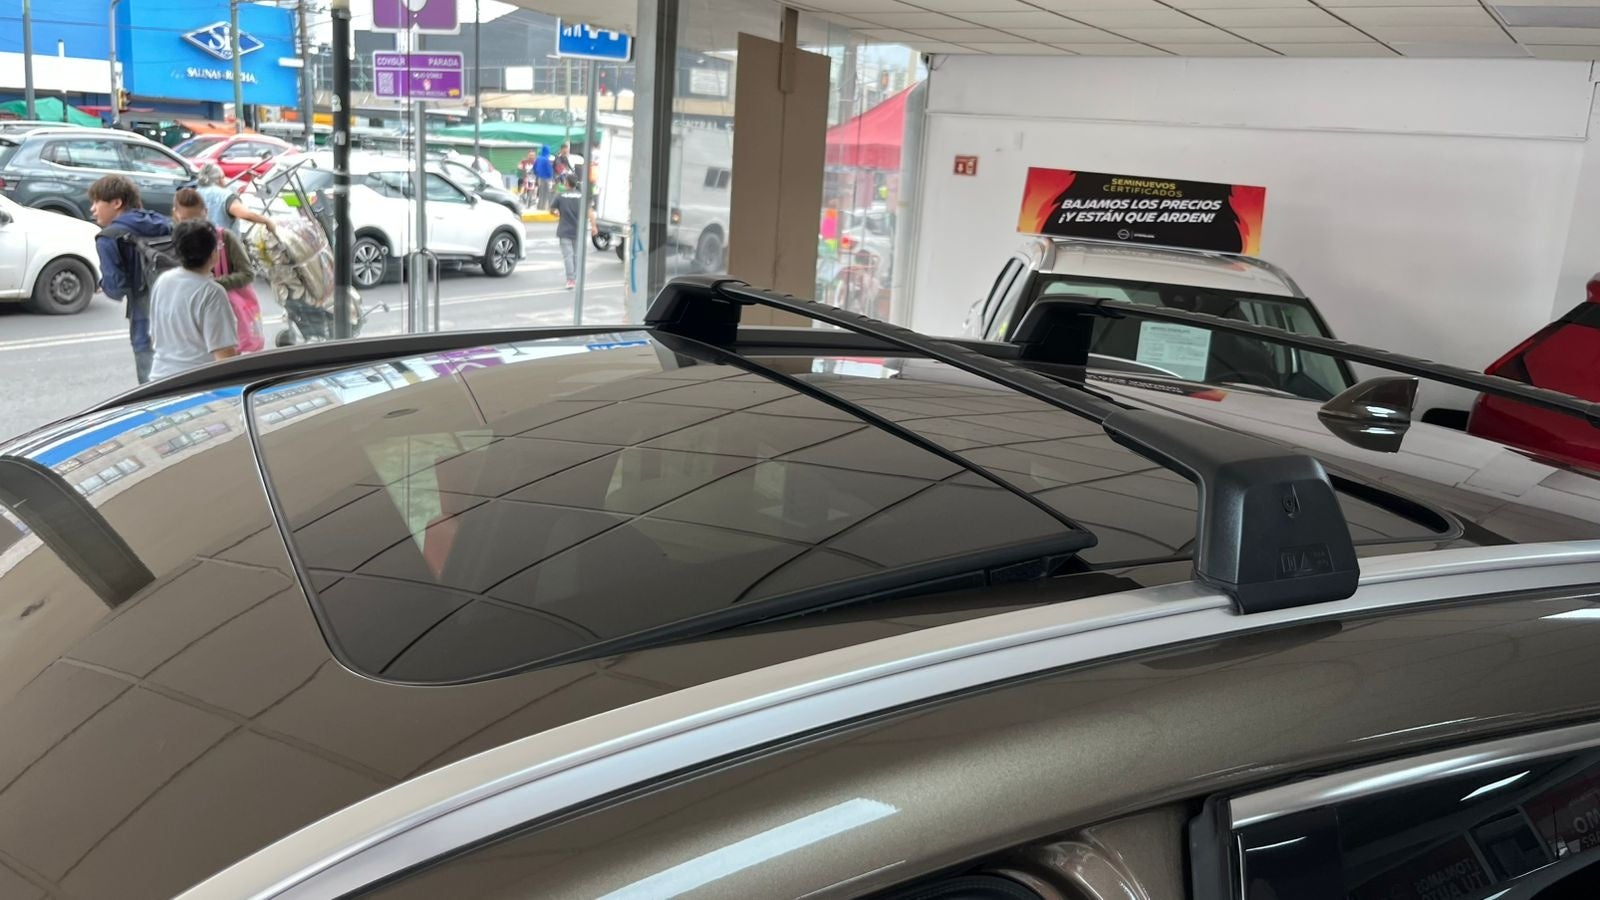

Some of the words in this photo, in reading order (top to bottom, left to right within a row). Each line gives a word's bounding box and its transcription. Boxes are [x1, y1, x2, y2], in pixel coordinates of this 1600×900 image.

[428, 58, 460, 67] PARADA
[186, 67, 222, 80] SALINAS
[1111, 178, 1176, 190] SEMINUEVOS
[1102, 185, 1183, 198] CERTIFICADOS
[1060, 199, 1131, 209] BAJAMOS
[1130, 199, 1159, 210] LOS
[1159, 199, 1222, 210] PRECIOS
[1058, 211, 1077, 224] ¡Y
[1075, 209, 1125, 222] ESTÁN
[1124, 211, 1158, 224] QUE
[1156, 212, 1216, 223] ARDEN!
